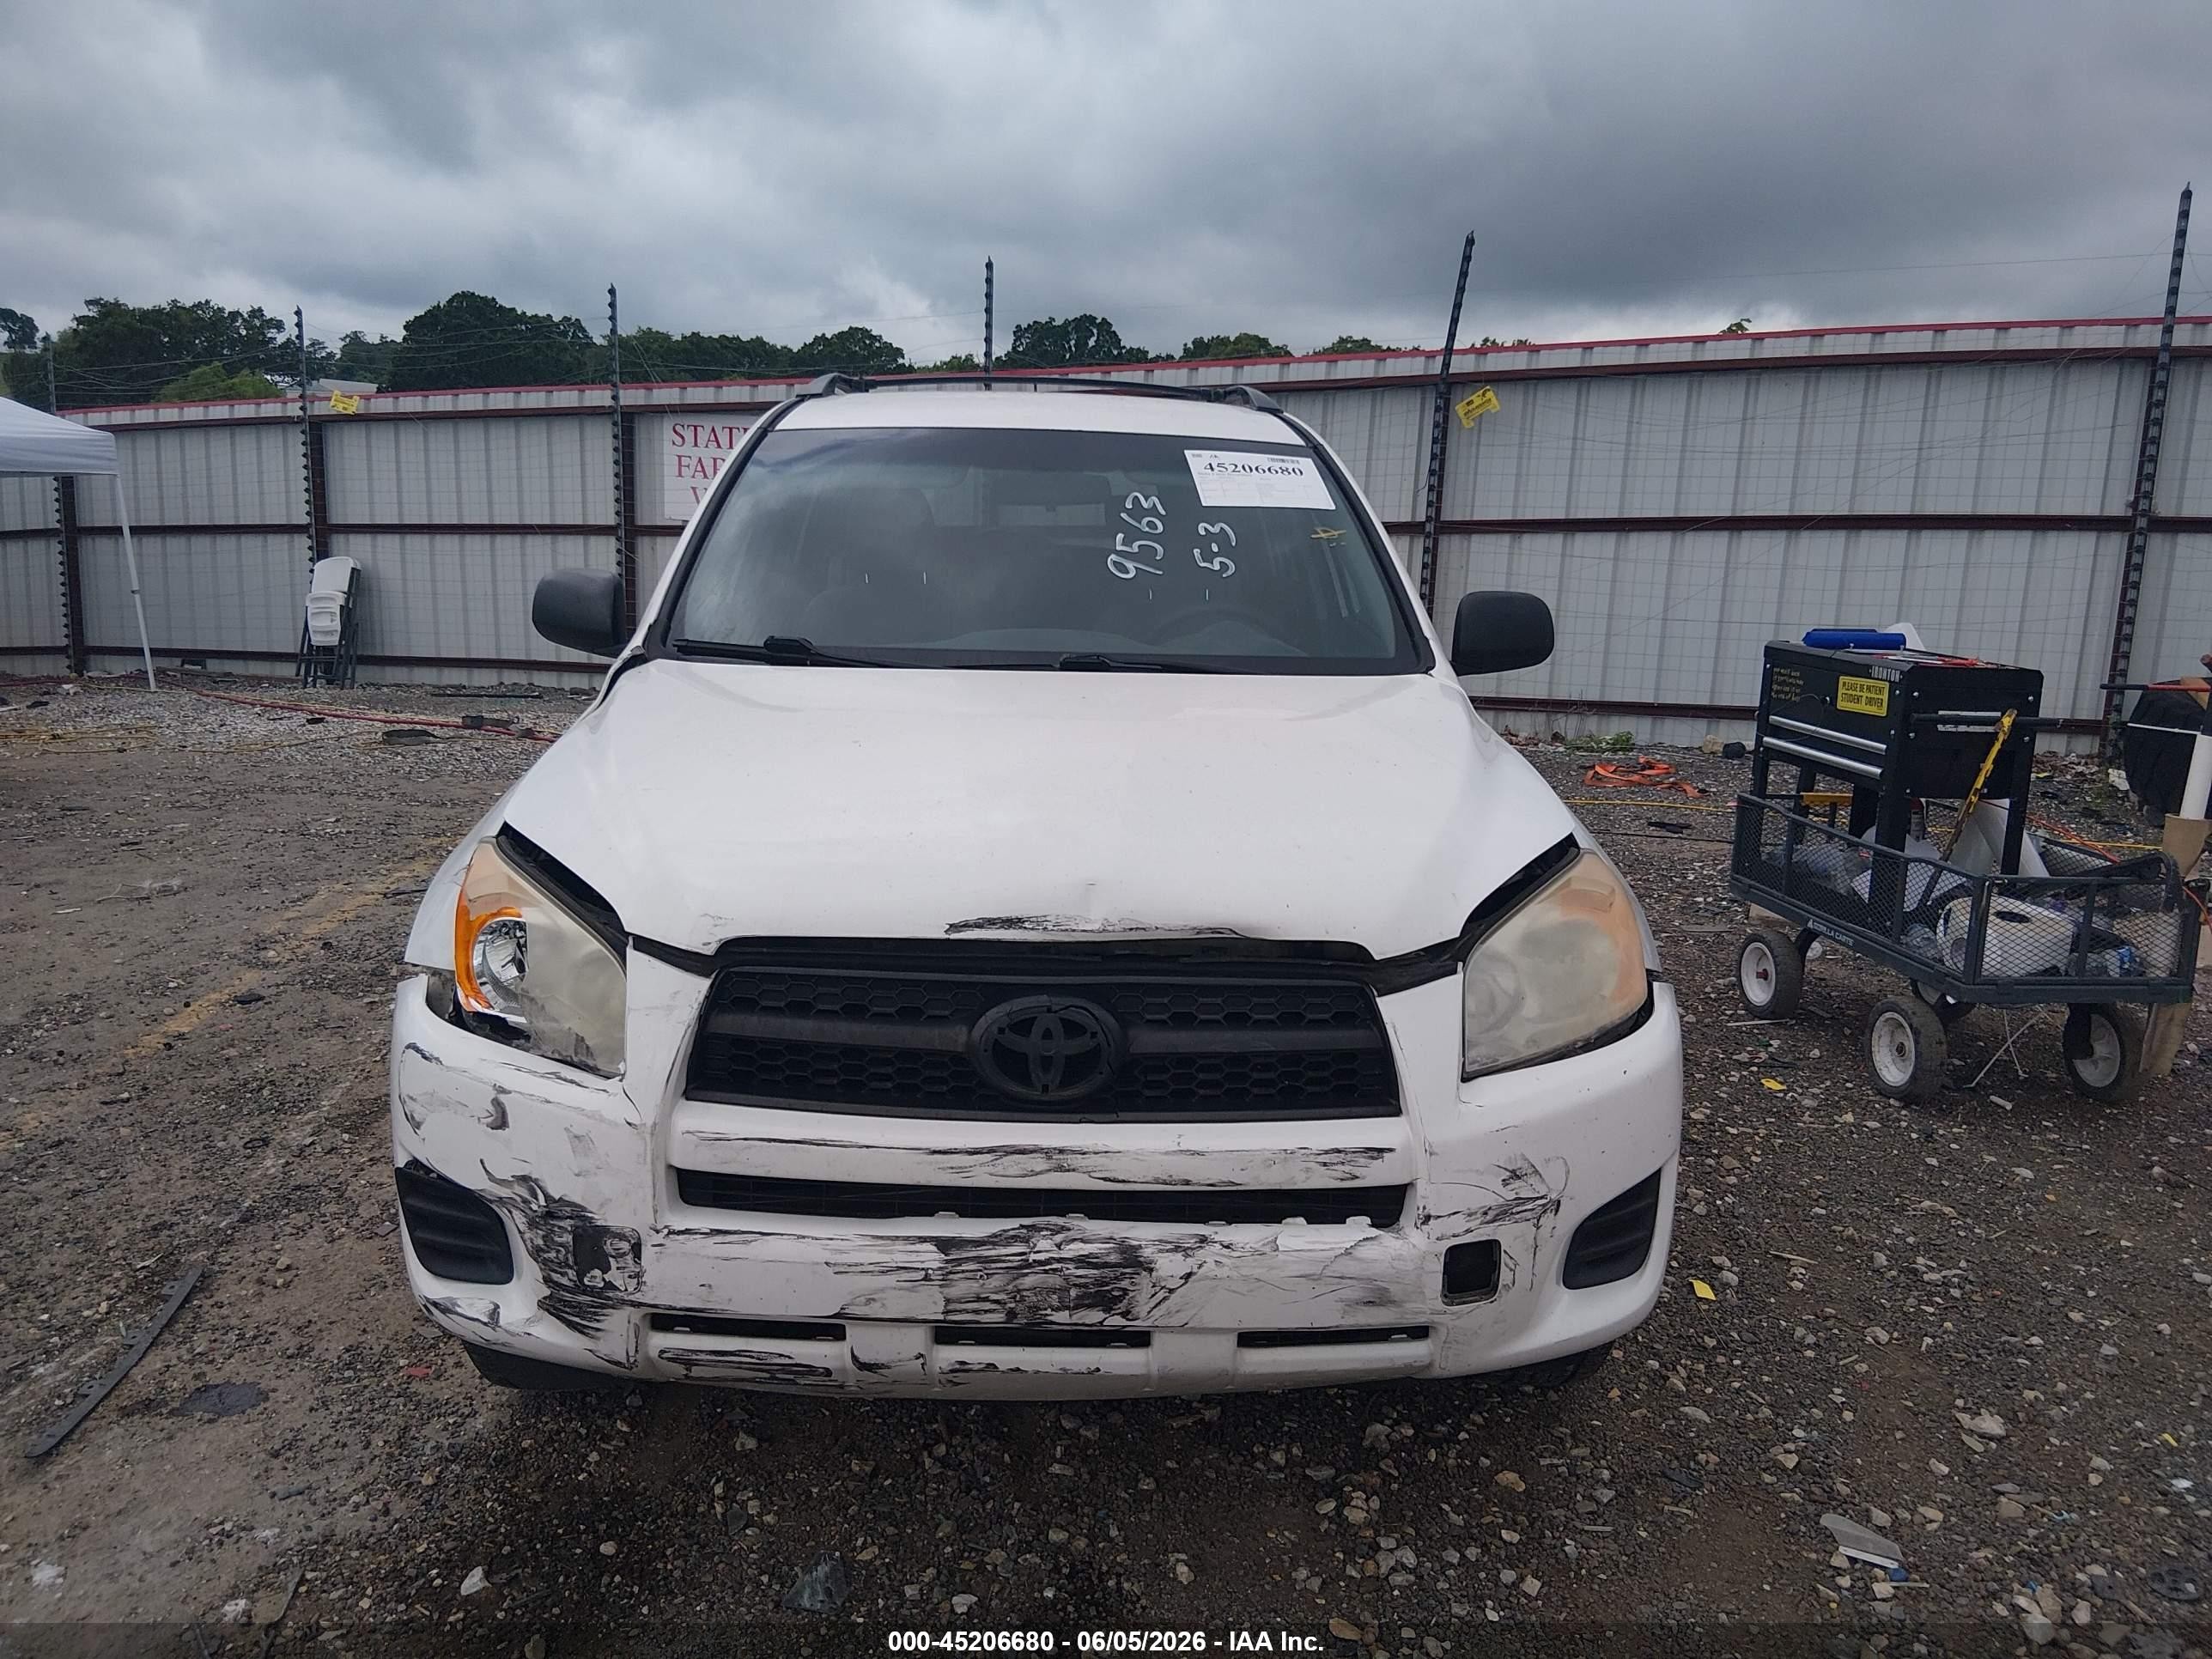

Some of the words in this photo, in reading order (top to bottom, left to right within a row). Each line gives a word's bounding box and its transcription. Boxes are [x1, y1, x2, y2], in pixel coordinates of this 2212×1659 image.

[672, 423, 750, 450] STAT
[1204, 462, 1304, 477] 45206680
[1107, 491, 1167, 580] 9563
[1842, 681, 1858, 692] PLEASE
[1865, 684, 1885, 696] PATIENT
[1840, 693, 1863, 705] STUDENT
[1865, 696, 1883, 708] DRIVER
